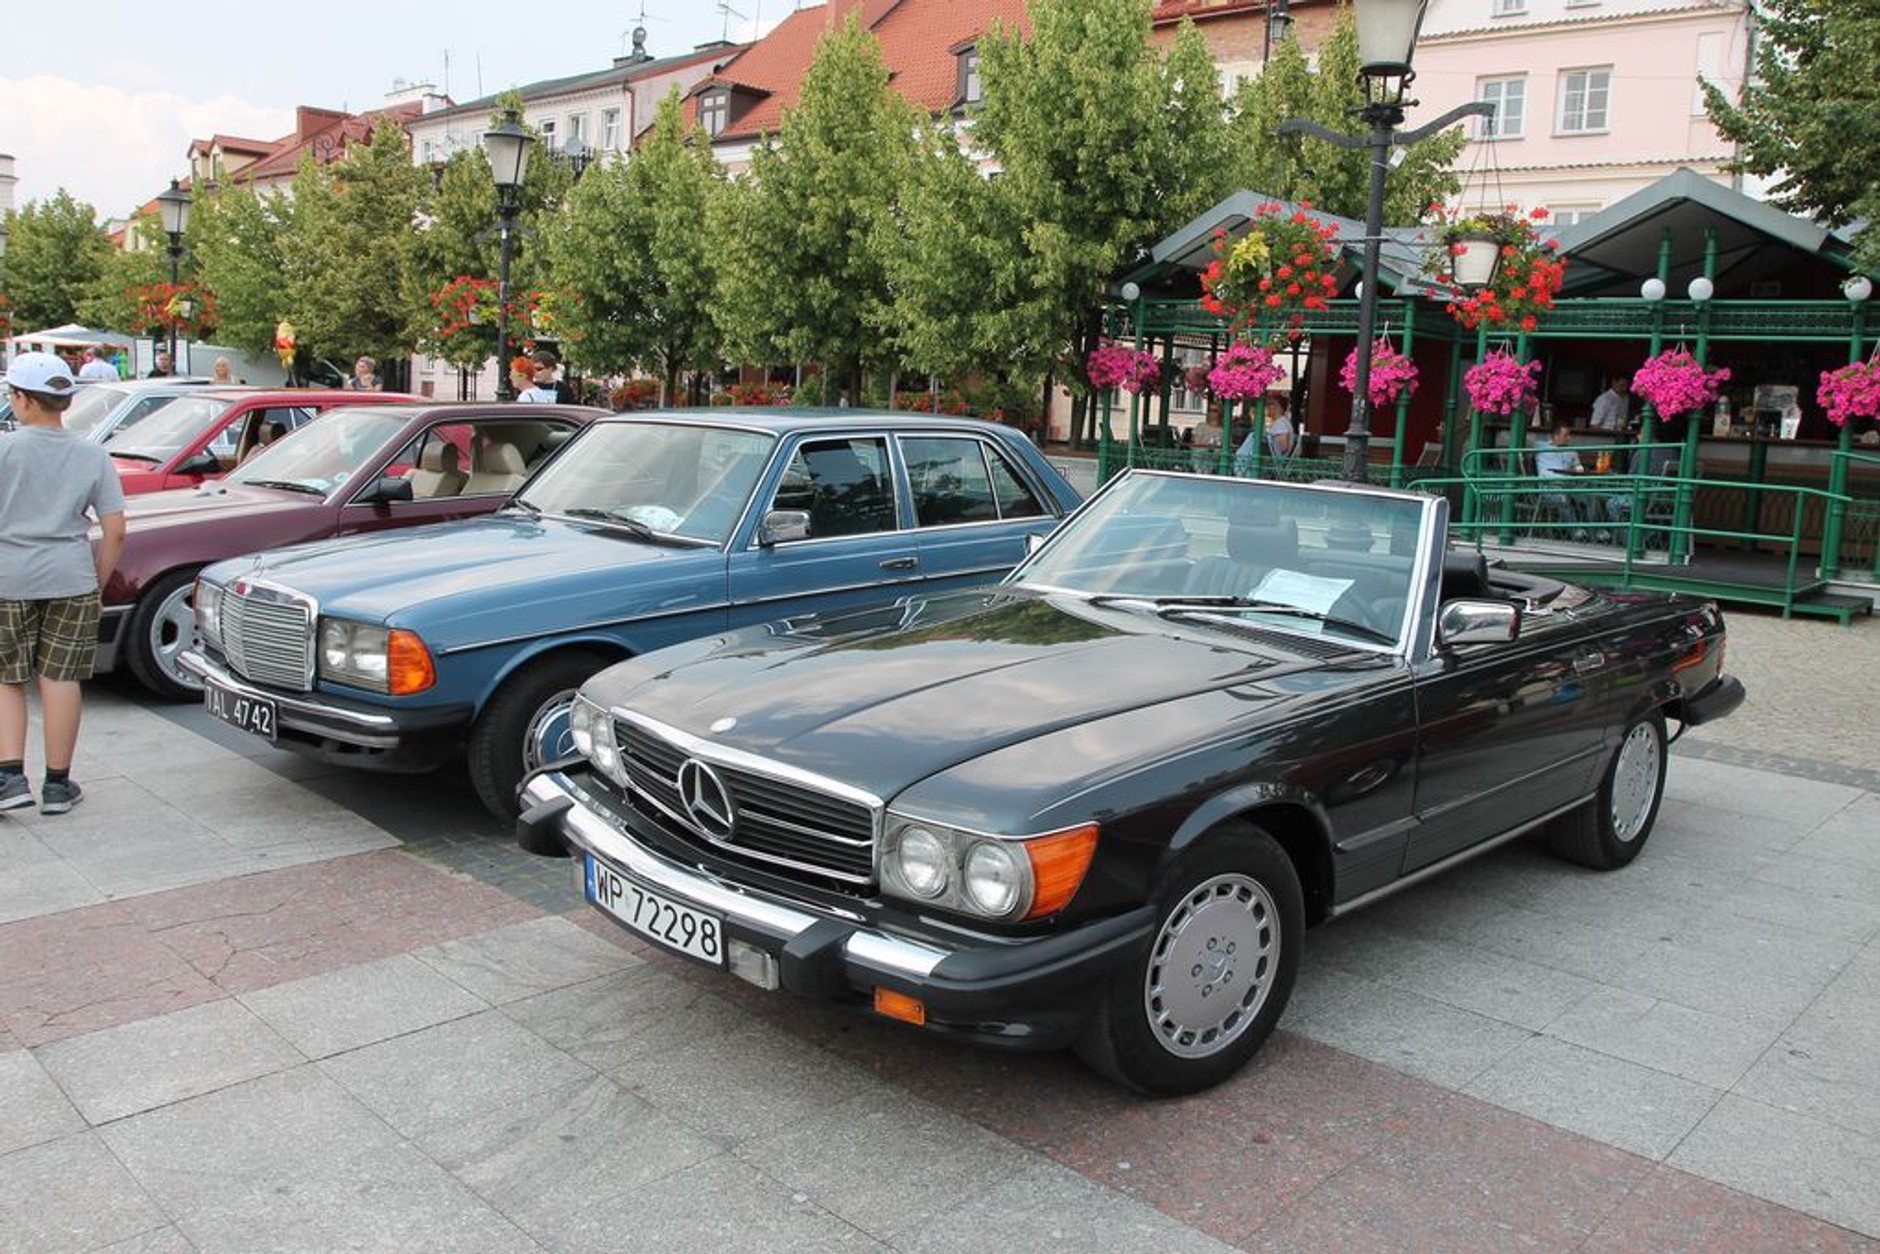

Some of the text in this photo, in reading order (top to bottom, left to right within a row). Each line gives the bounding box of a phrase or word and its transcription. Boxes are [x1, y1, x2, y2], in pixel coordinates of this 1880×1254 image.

[206, 686, 270, 734] TAL 4742
[597, 864, 718, 957] WP 72298
